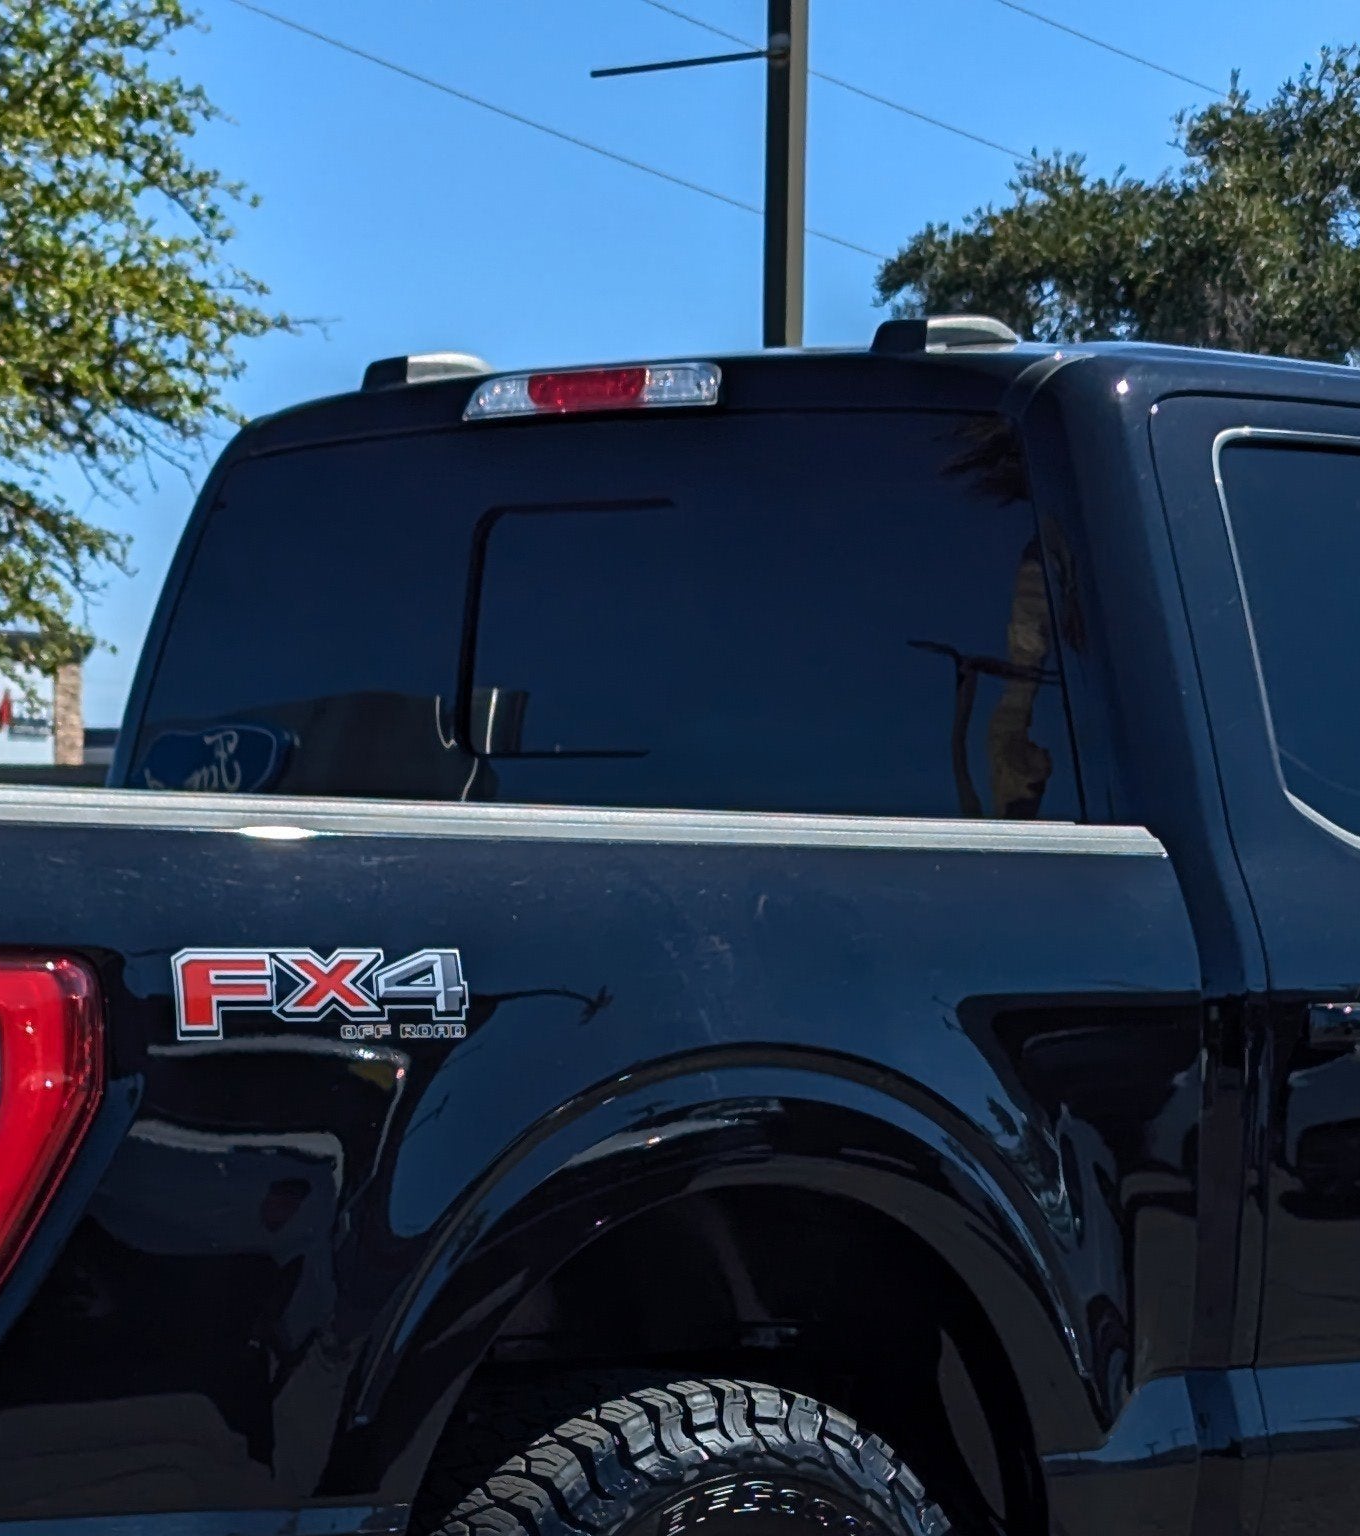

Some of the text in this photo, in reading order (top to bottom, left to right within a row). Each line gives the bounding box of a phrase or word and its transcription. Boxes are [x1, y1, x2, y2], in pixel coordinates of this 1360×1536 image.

[171, 948, 469, 1040] FX4
[340, 1023, 467, 1039] OFF ROAD
